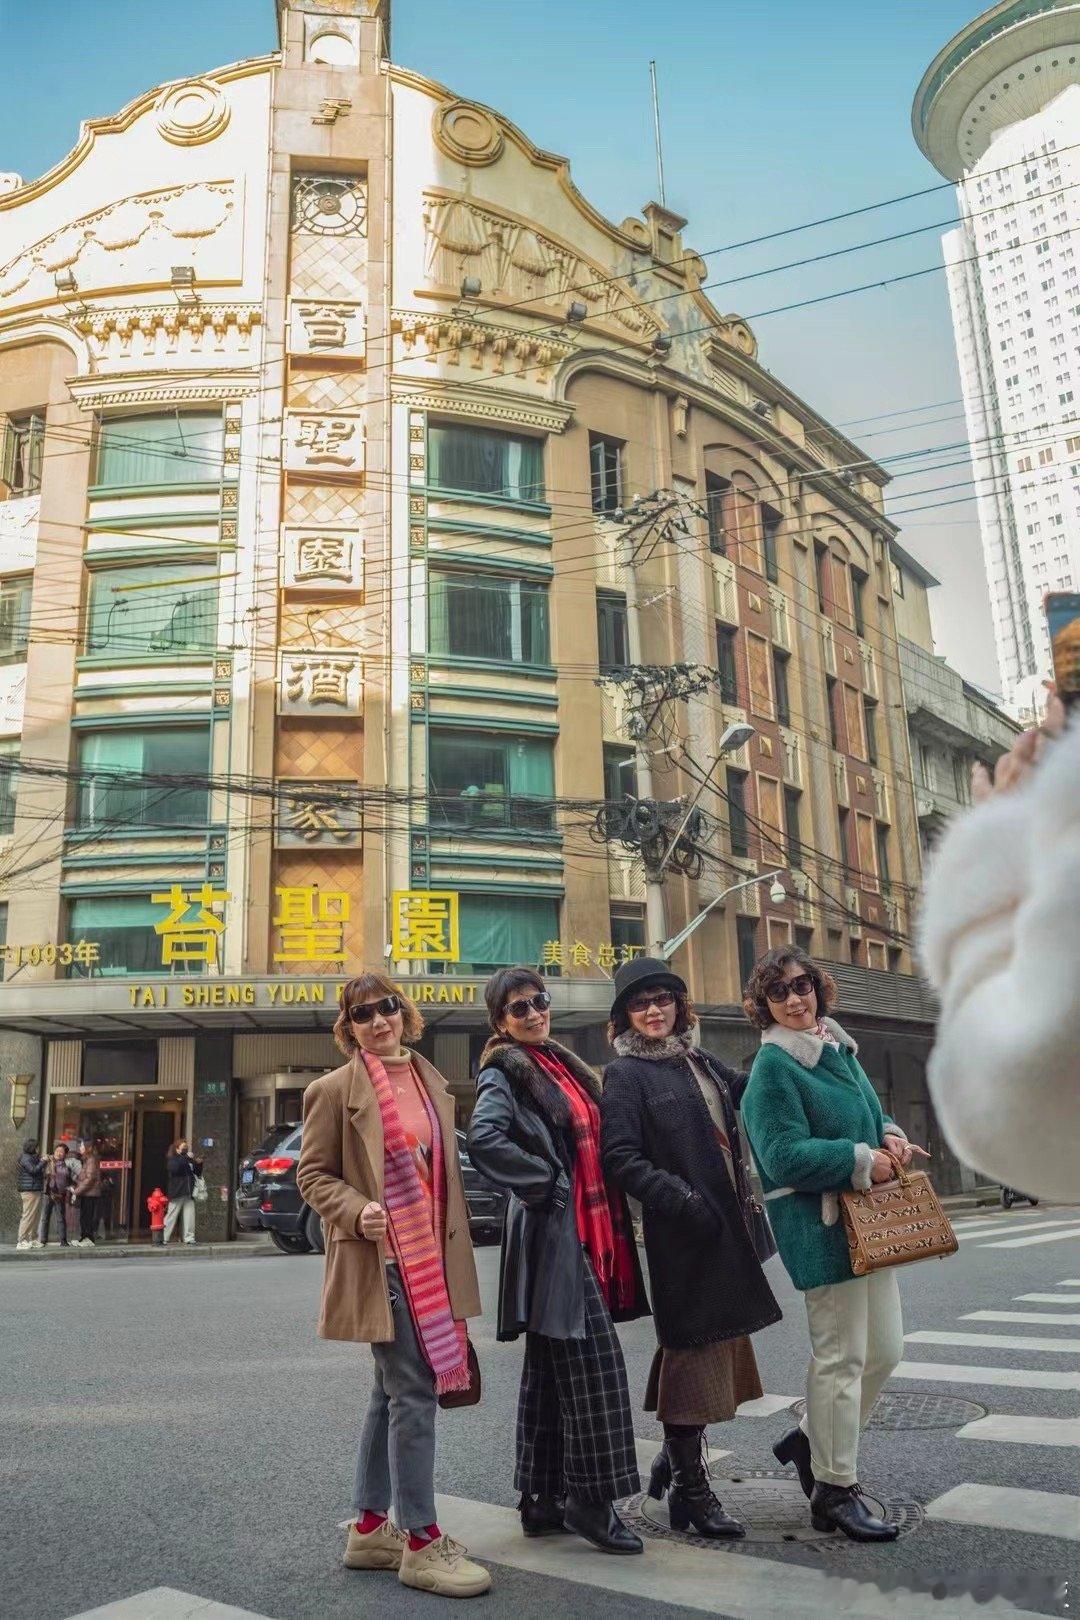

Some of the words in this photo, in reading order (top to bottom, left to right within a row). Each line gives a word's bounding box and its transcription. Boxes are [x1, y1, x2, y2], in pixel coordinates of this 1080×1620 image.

[129, 984, 168, 1008] TAI
[182, 984, 255, 1006] SHENG
[267, 983, 324, 1003] YUAN
